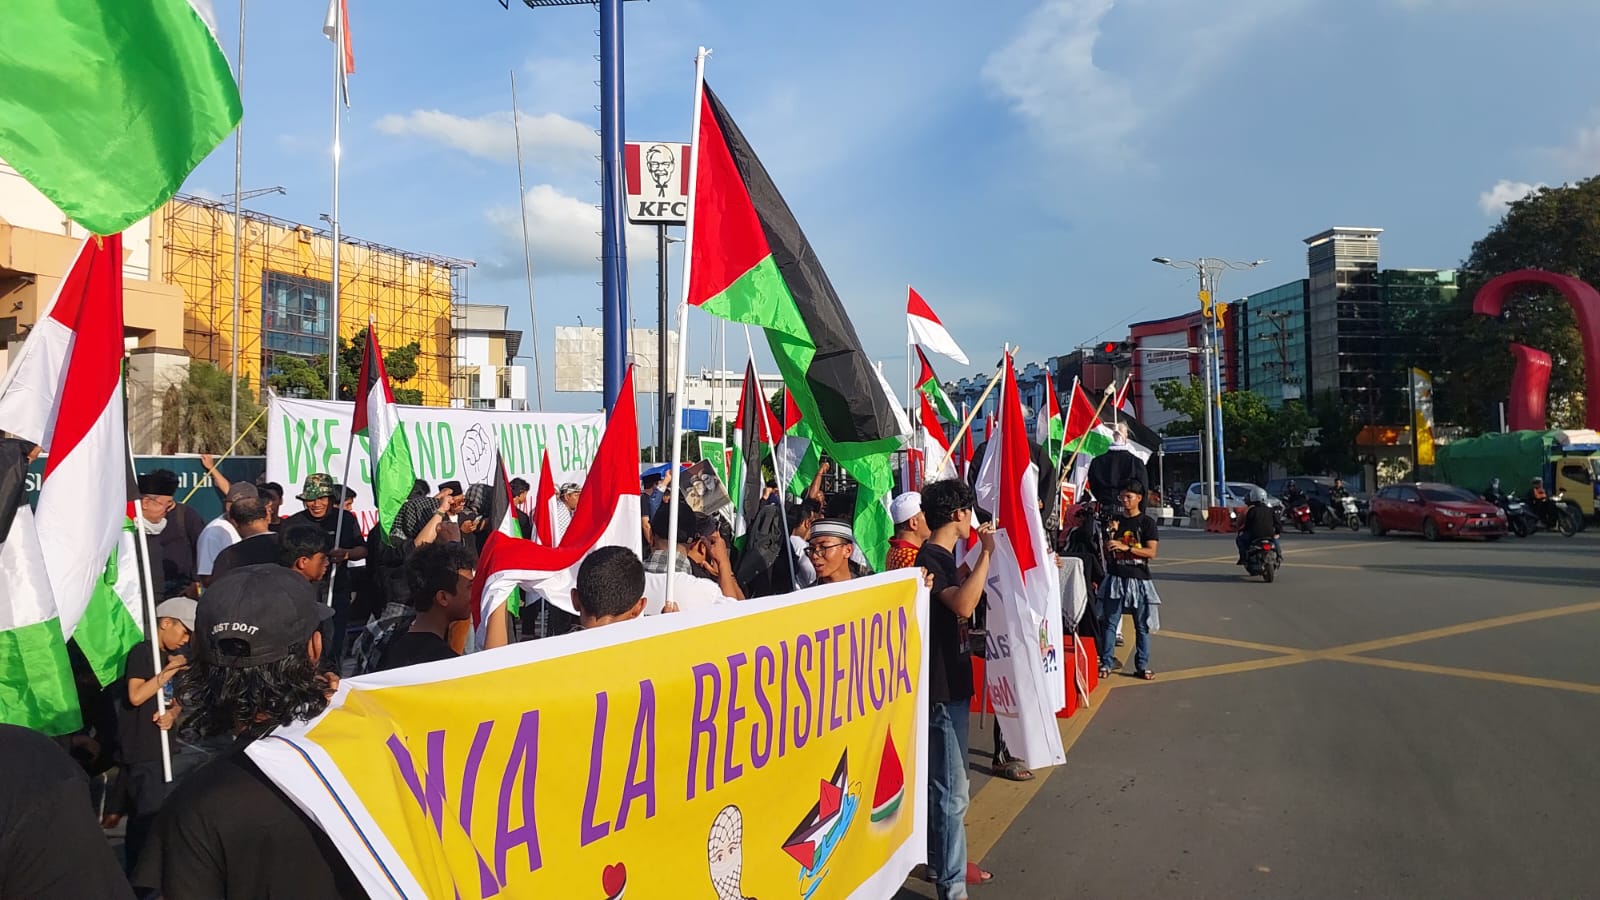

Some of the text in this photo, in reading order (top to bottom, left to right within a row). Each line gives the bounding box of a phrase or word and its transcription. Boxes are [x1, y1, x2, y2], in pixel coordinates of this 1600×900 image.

[637, 201, 686, 217] KFC
[283, 414, 341, 484] WE
[211, 622, 259, 635] UST DO IT
[581, 679, 656, 847] LA
[686, 606, 912, 801] RESISTENCIA
